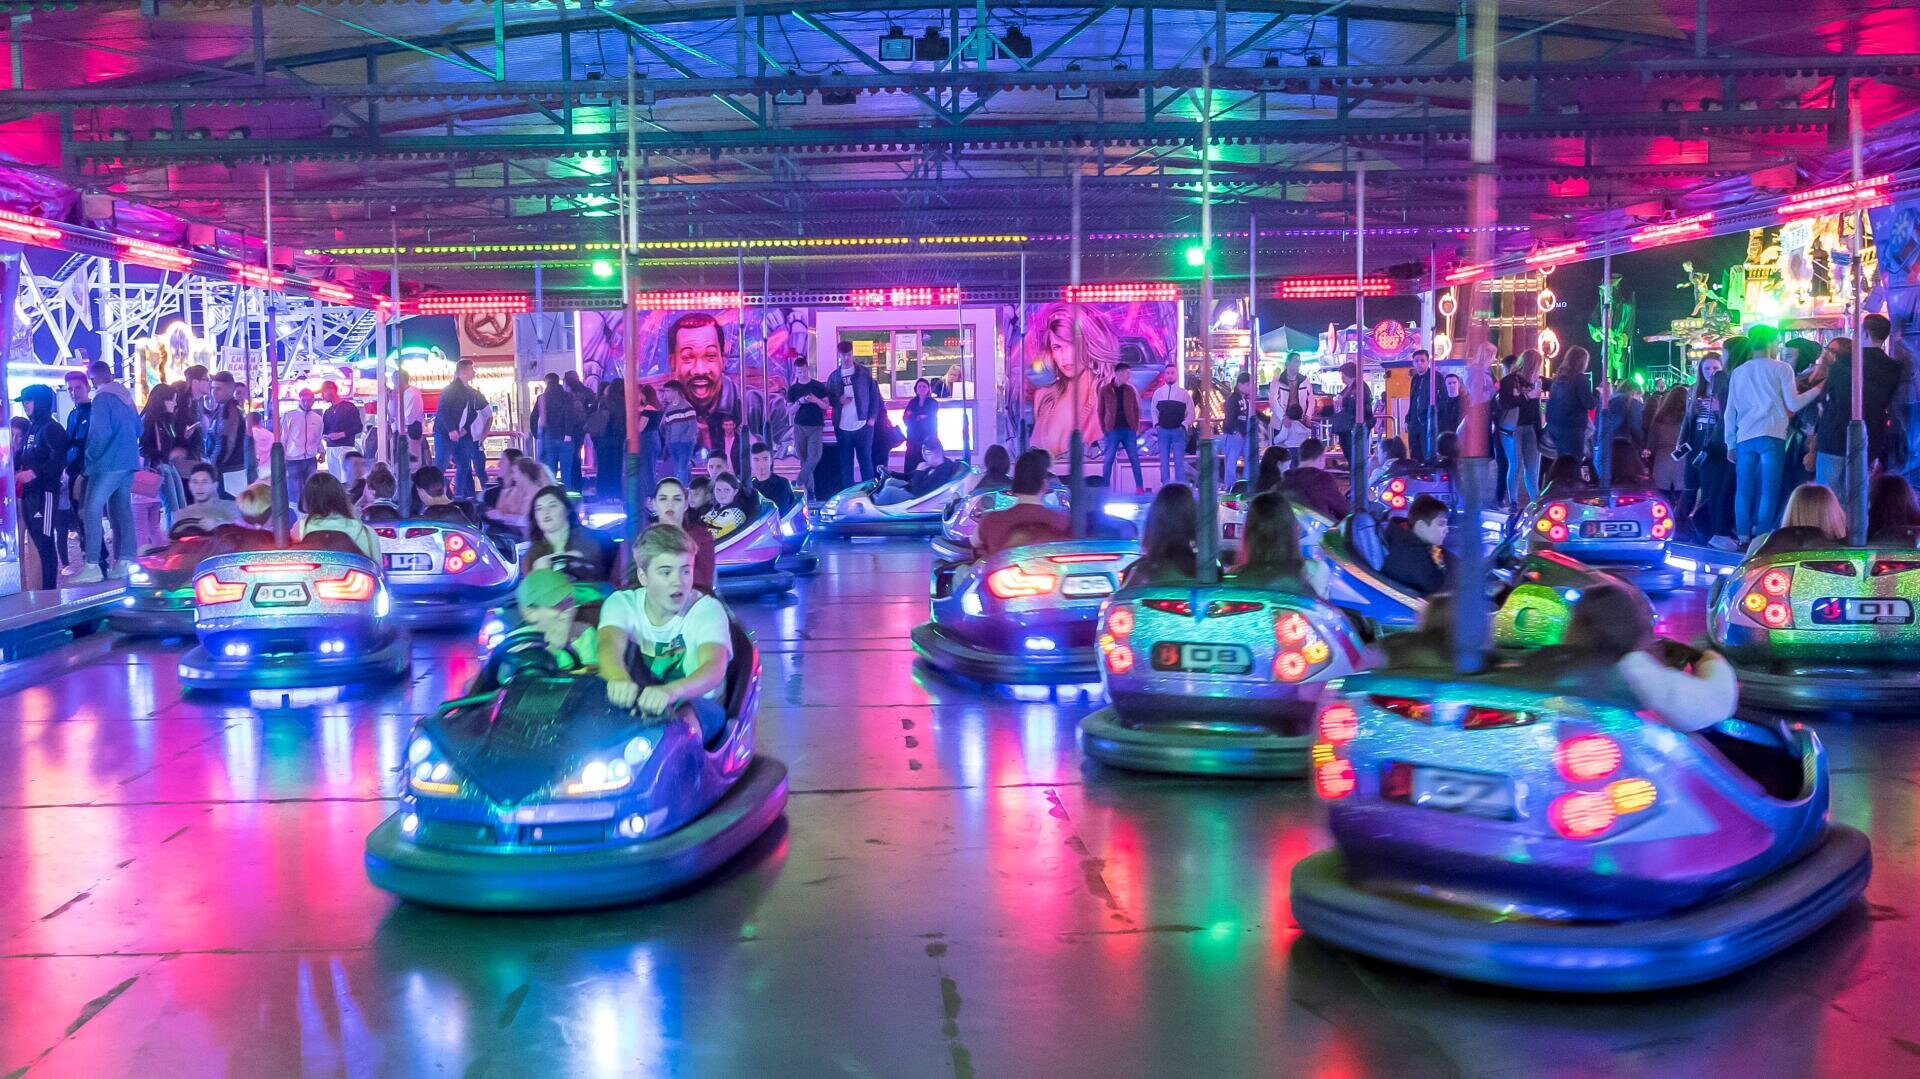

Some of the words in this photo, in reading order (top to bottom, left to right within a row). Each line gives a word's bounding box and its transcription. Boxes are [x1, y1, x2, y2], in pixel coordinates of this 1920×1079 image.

[1604, 523, 1633, 532] 20
[272, 588, 301, 599] 04
[1859, 603, 1894, 615] 01
[1190, 648, 1238, 663] 08
